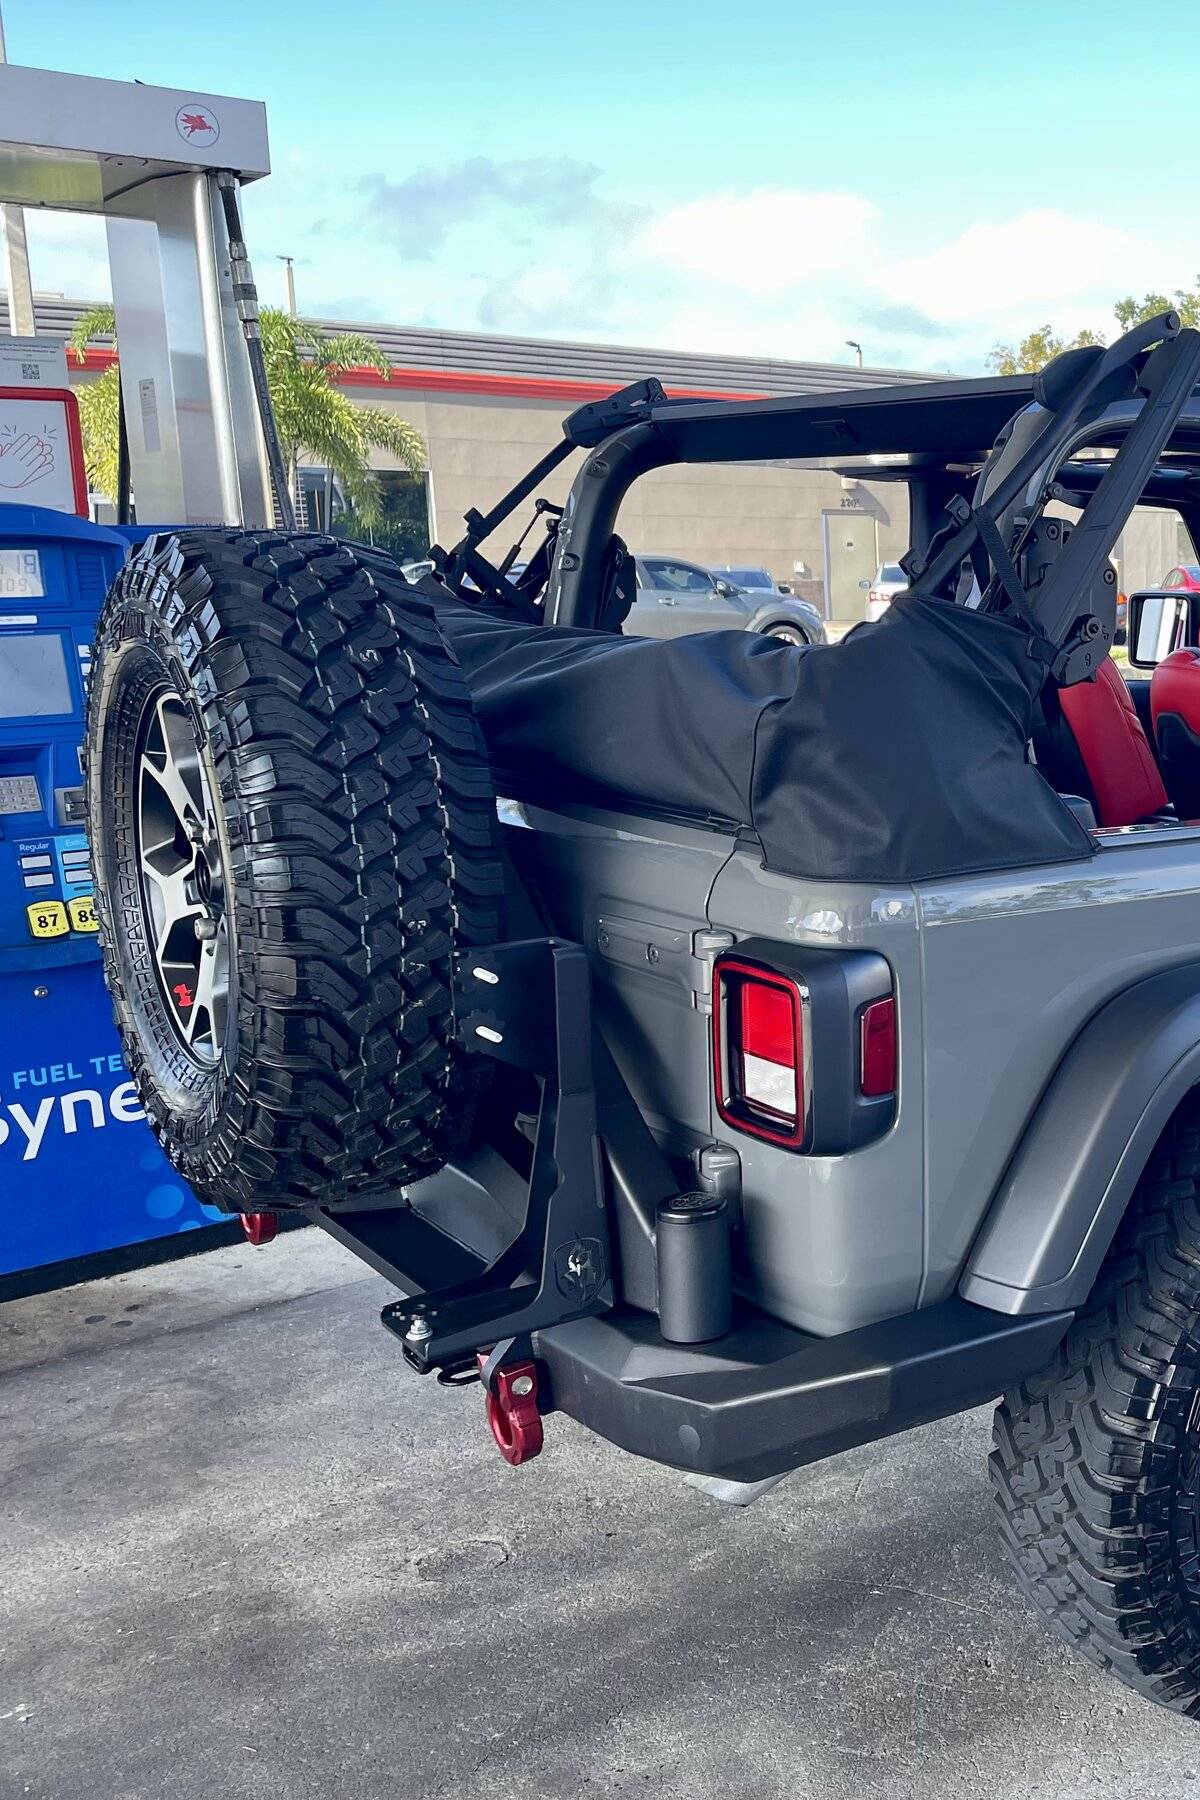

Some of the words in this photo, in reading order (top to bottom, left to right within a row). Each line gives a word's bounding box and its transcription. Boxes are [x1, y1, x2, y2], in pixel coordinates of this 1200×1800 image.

[20, 842, 49, 853] Regular
[37, 913, 58, 928] 87
[13, 1062, 82, 1090] FUEL
[0, 1080, 148, 1161] yne
